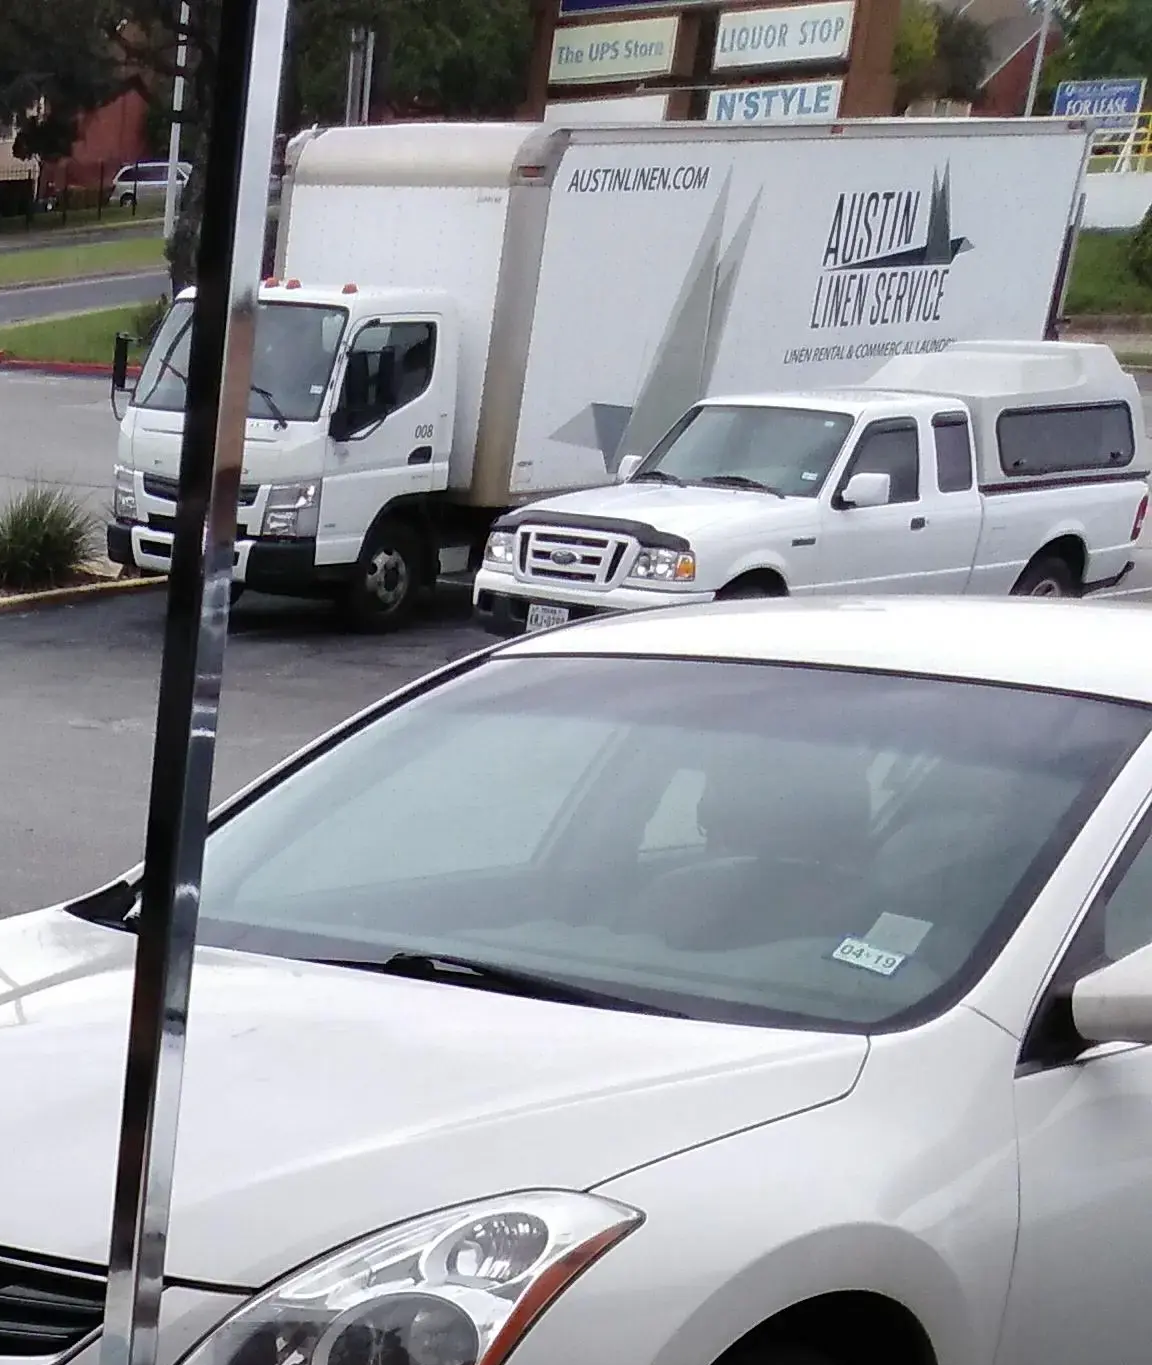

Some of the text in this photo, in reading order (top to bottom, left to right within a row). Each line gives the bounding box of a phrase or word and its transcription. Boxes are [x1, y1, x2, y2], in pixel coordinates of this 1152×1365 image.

[720, 16, 845, 53] LIQUOR STOP
[557, 39, 664, 65] The UPS Store
[716, 85, 833, 121] N'STYLE
[1065, 97, 1128, 117] FOR LEASE
[567, 166, 710, 193] AUSTINLINEN.COM
[822, 190, 921, 267] AUSTIN
[810, 269, 950, 329] LINEN SERVICE
[783, 348, 813, 364] LINEN
[812, 345, 845, 361] RENTAL
[846, 344, 854, 359] &
[855, 340, 913, 359] COMMERCAL
[415, 424, 433, 438] 008
